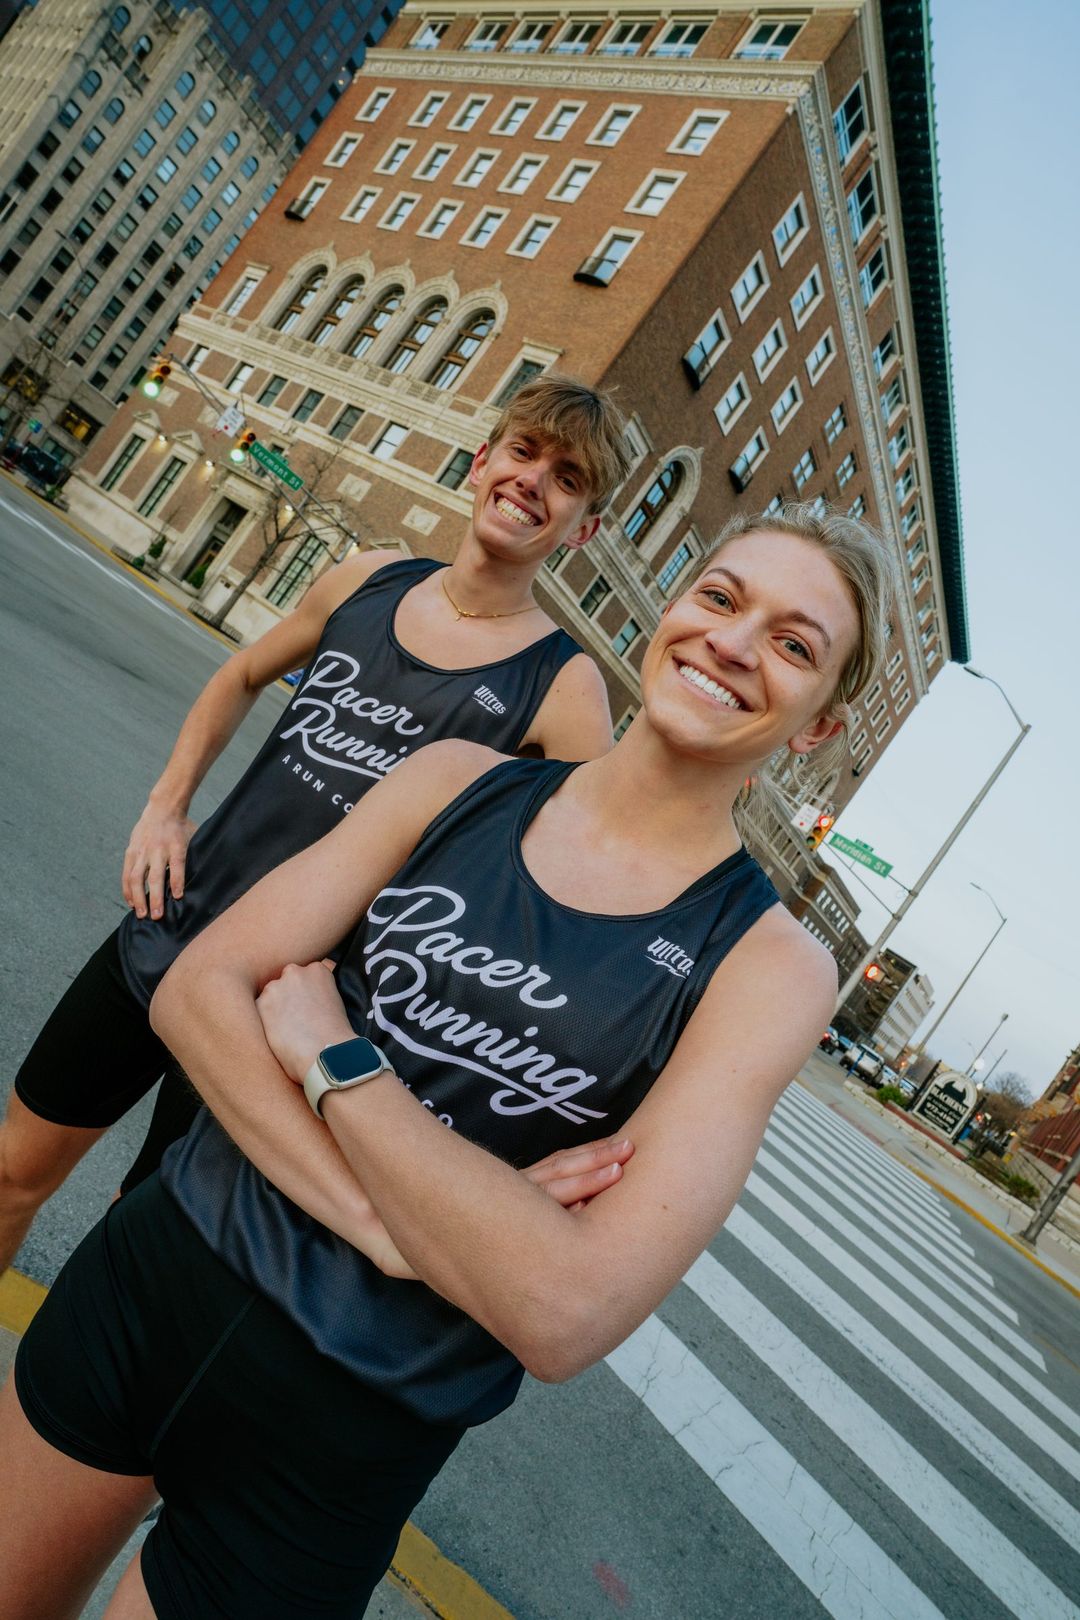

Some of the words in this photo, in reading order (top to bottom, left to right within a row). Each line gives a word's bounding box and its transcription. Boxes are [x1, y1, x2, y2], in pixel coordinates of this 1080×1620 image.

[253, 444, 288, 480] Vermont
[289, 476, 300, 488] St
[299, 650, 424, 735] Pacer
[473, 684, 506, 715] Ultras
[279, 697, 406, 780] Runni
[282, 754, 291, 764] A
[292, 763, 325, 792] RUN
[833, 836, 872, 866] Meridian
[873, 861, 886, 873] St
[363, 885, 568, 1009] Pacer
[364, 948, 609, 1125] Running
